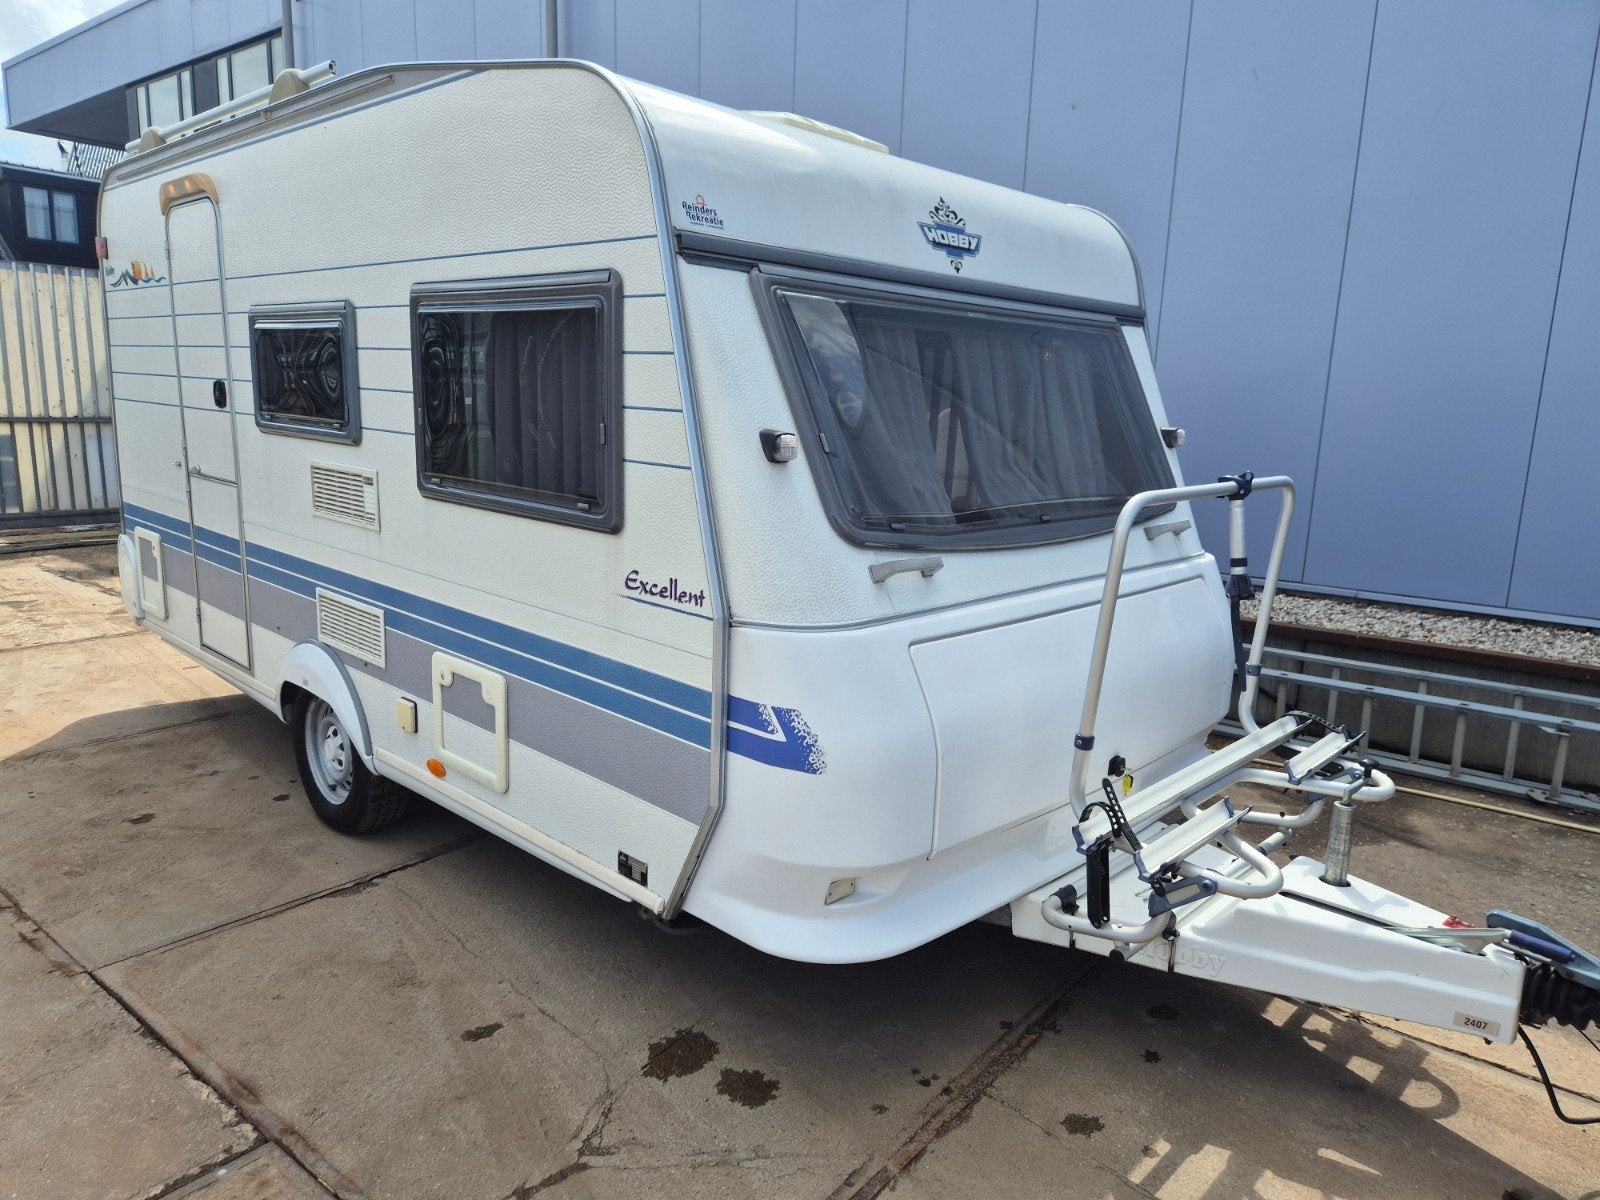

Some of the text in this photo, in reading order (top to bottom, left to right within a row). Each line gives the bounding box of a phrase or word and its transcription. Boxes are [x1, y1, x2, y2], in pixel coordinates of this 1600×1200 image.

[682, 201, 718, 216] Reinders
[686, 210, 724, 226] Rekreatie
[922, 226, 980, 251] HOBBY
[624, 569, 706, 608] Excellent
[1463, 1017, 1488, 1030] 2407
